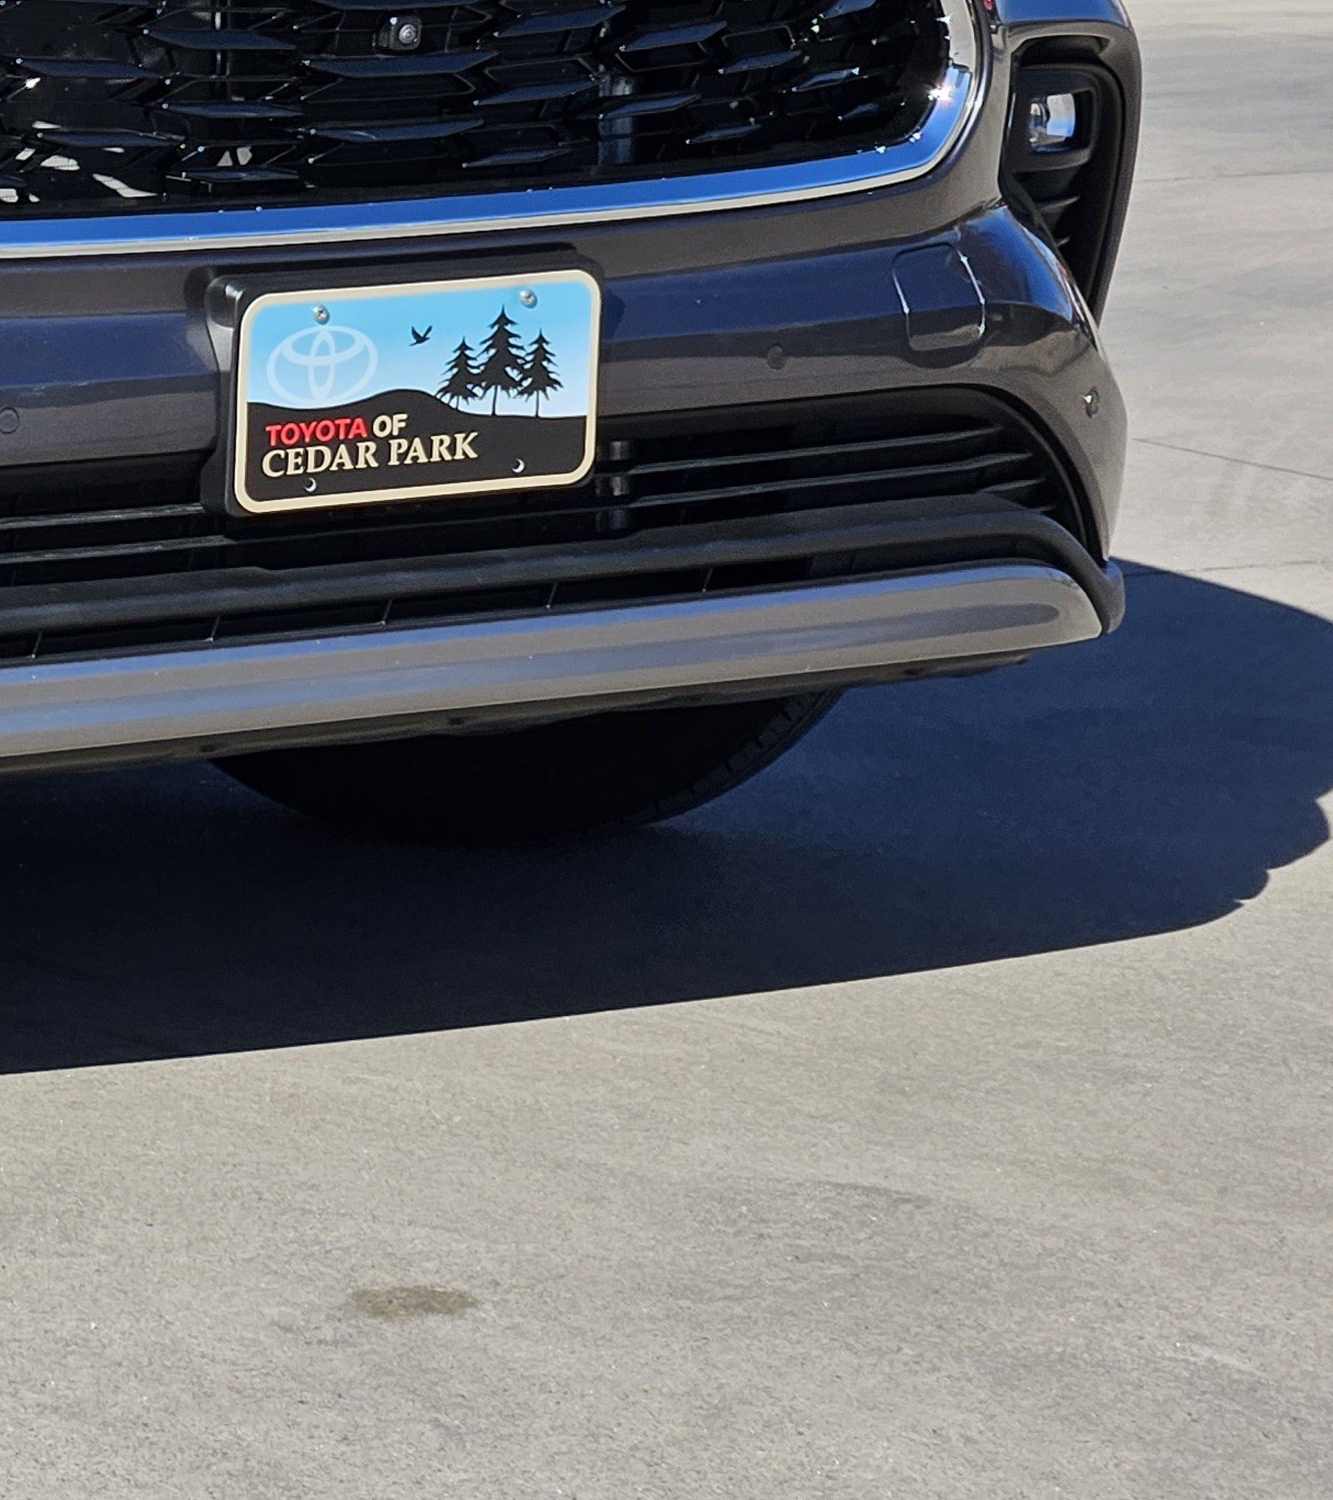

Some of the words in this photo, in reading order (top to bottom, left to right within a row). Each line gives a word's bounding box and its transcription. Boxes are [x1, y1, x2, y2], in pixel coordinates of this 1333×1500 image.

[265, 417, 368, 446] TOYOTA
[372, 413, 409, 438] OF
[261, 441, 379, 477] CEDAR
[387, 432, 479, 466] PARK
